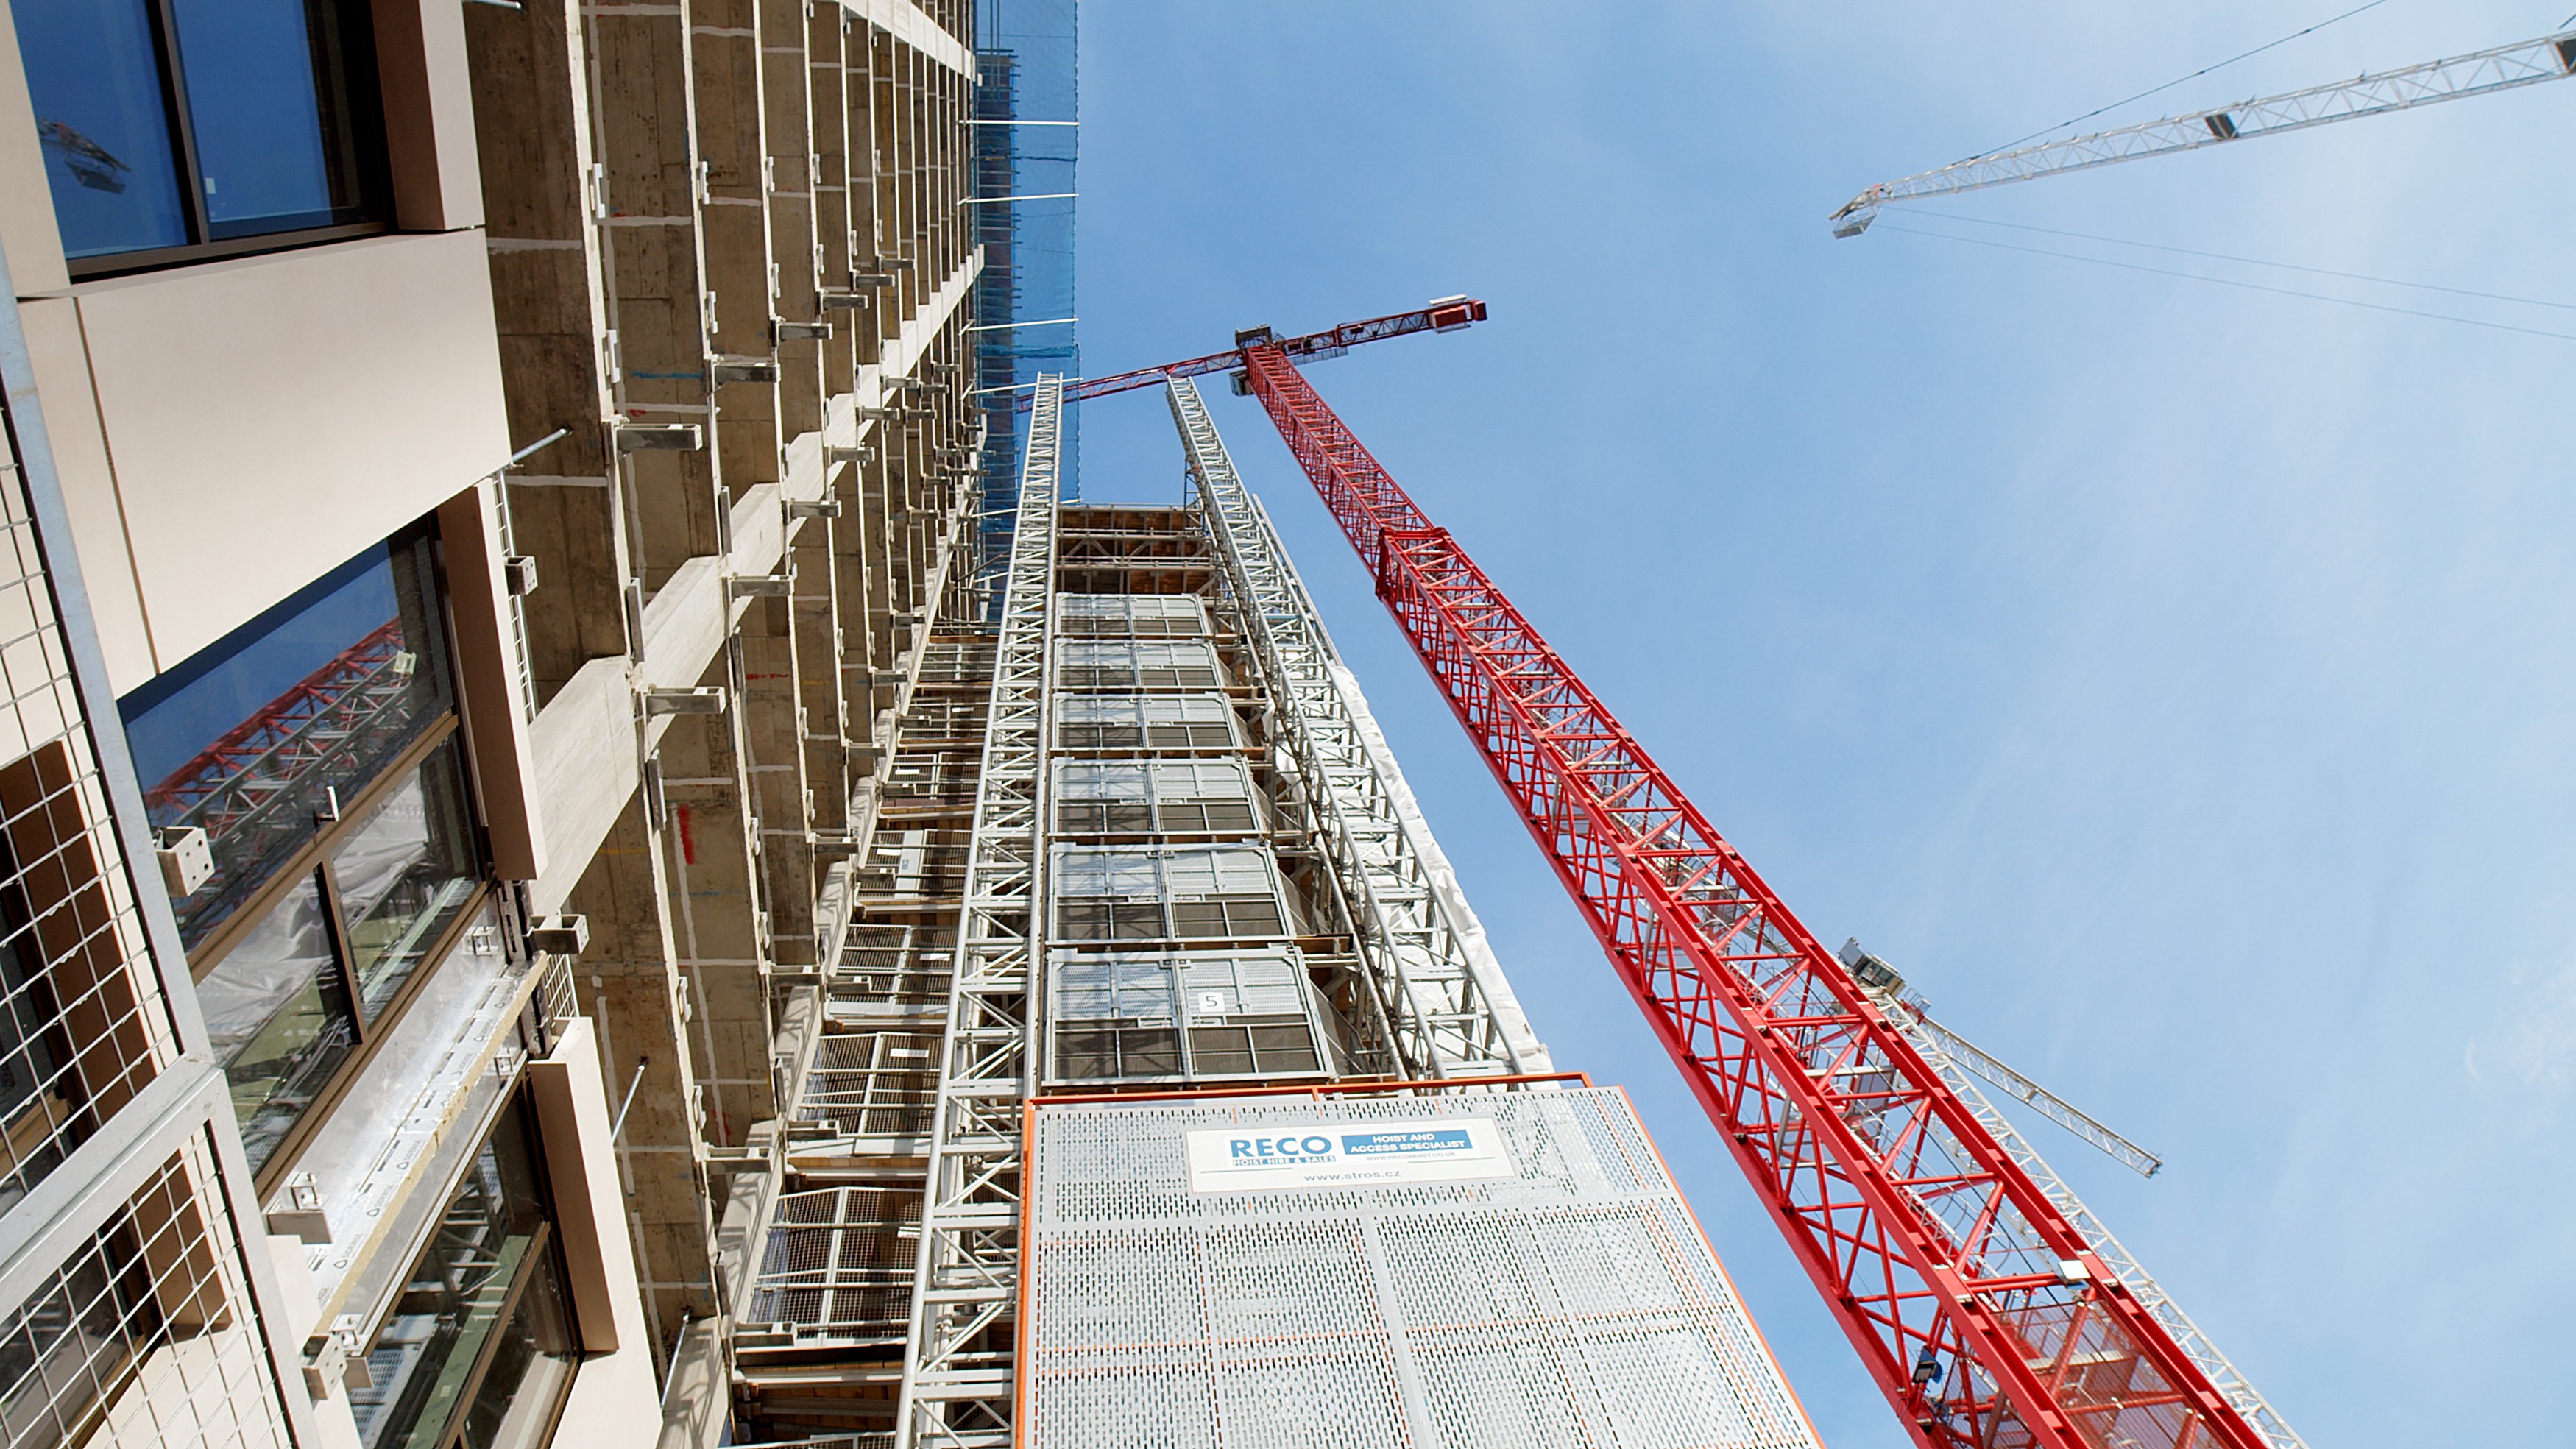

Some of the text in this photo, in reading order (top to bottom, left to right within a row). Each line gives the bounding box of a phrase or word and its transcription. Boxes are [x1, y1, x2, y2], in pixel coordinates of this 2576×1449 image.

[1206, 996, 1217, 1007] 5
[1372, 1133, 1435, 1144] HOIST AND
[1230, 1136, 1332, 1158] RECO
[1351, 1140, 1465, 1153] ACCESS SPECIALIST
[1233, 1158, 1264, 1166] HOIST
[1267, 1157, 1290, 1165] HIRE
[1305, 1155, 1337, 1163] SALES
[1303, 1170, 1401, 1181] www.stros.cz
